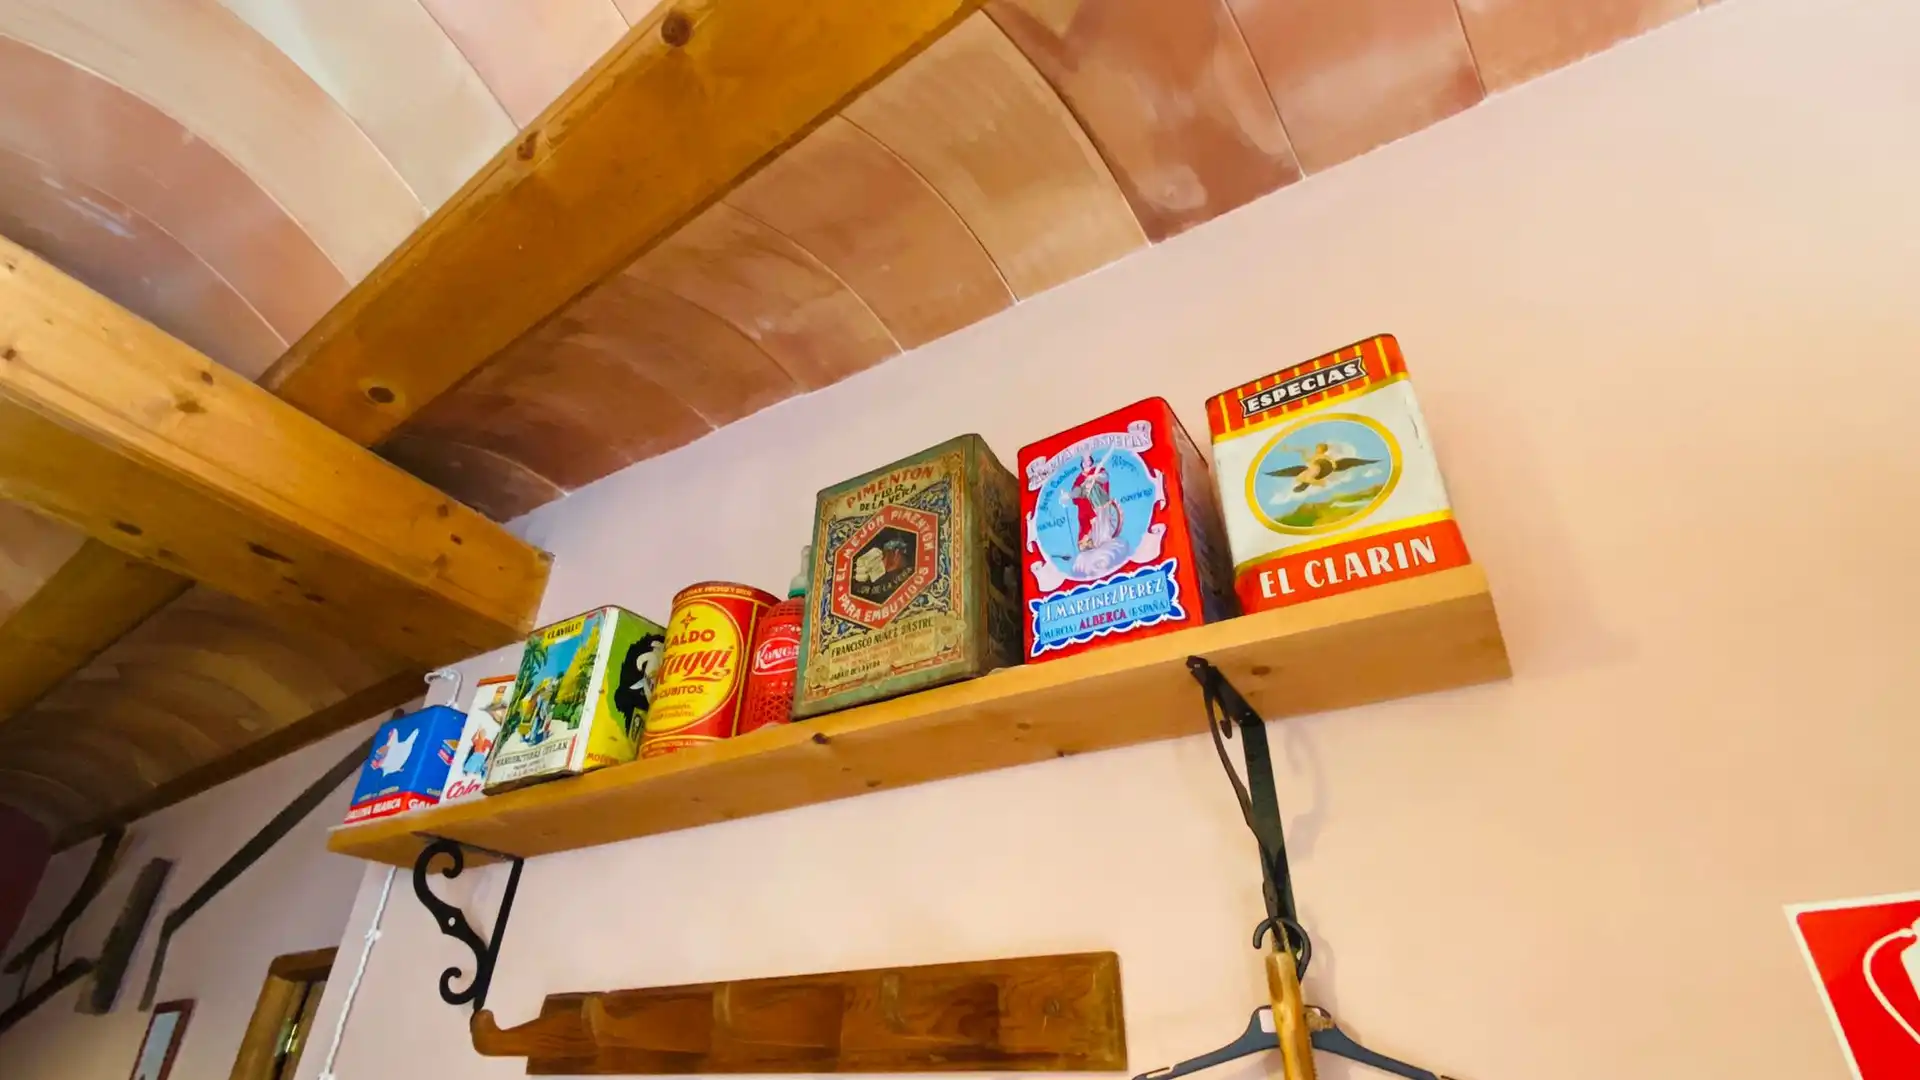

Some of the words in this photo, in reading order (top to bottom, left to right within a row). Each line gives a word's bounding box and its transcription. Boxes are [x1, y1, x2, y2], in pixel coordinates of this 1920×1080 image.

[1246, 363, 1358, 413] ESPECIAS
[846, 465, 934, 508] PIMENTON
[859, 502, 870, 511] DE
[872, 499, 884, 510] LA
[836, 563, 848, 581] EL
[843, 515, 885, 558] MEJOR
[1259, 567, 1297, 599] EL
[1304, 535, 1436, 588] CLARIN
[838, 594, 861, 620] PARA
[864, 566, 929, 622] EMBUTIDOS
[1119, 577, 1164, 601] PEREZ
[1079, 608, 1128, 631] ALBERCA
[831, 636, 872, 658] FRANCISCO
